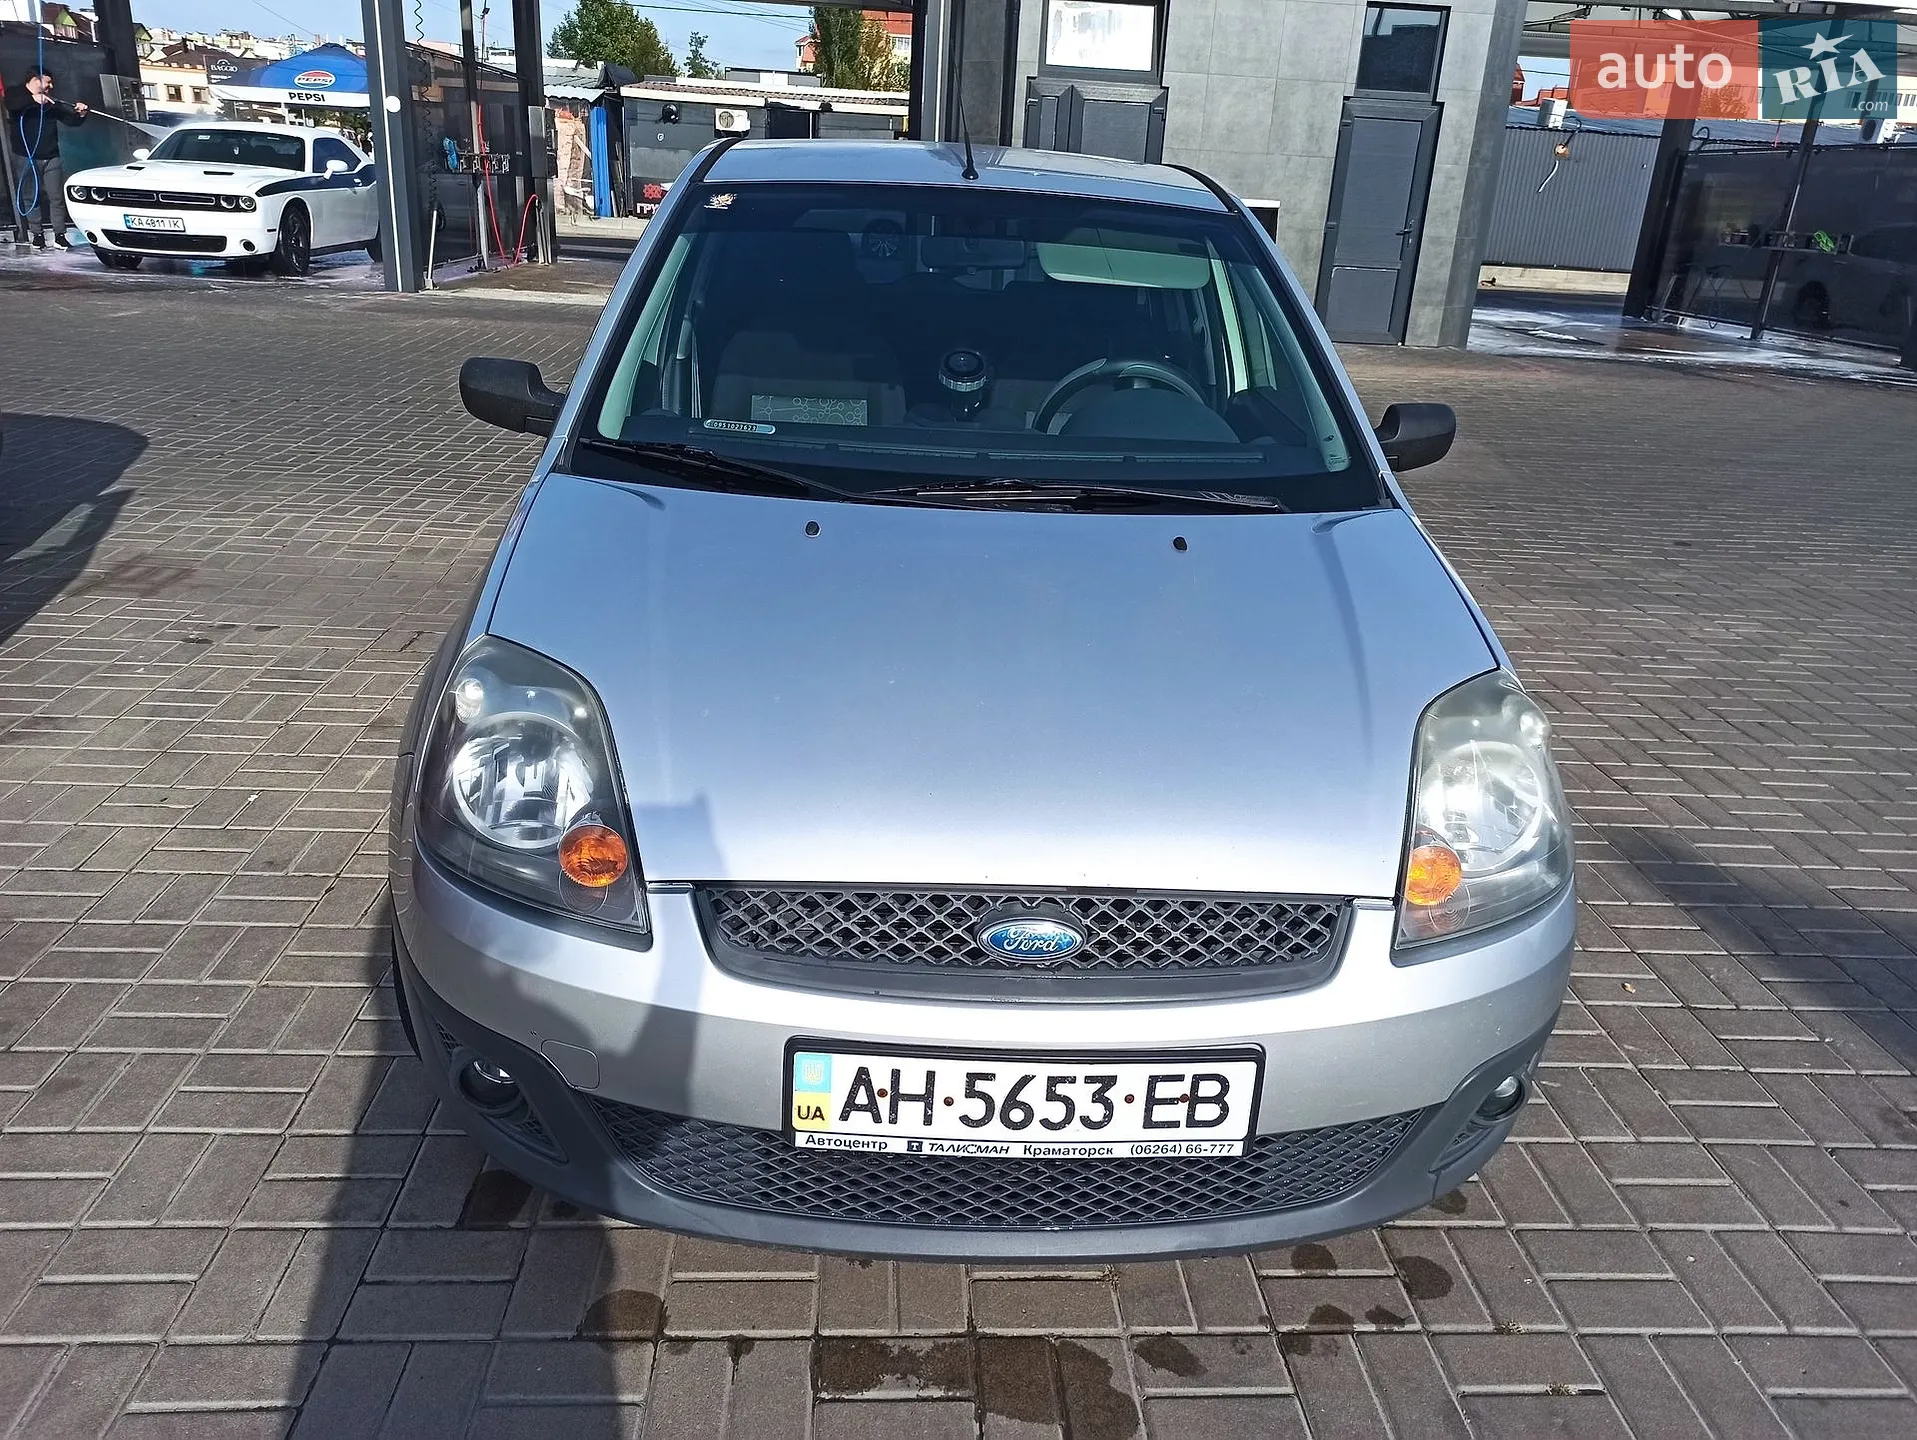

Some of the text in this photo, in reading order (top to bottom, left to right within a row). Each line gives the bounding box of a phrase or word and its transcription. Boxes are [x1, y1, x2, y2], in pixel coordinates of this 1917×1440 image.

[297, 76, 333, 84] PEPSI
[288, 91, 326, 102] PEPSI
[1000, 927, 1059, 951] Ford
[958, 1071, 1117, 1131] 5653
[797, 1104, 825, 1121] UA
[805, 1134, 888, 1151] Автоцентр
[929, 1142, 1010, 1155] ТАЛИСМАН
[1023, 1144, 1113, 1158] Краматорск
[1130, 1143, 1182, 1156] (06264)
[1186, 1143, 1234, 1155] 66-777
